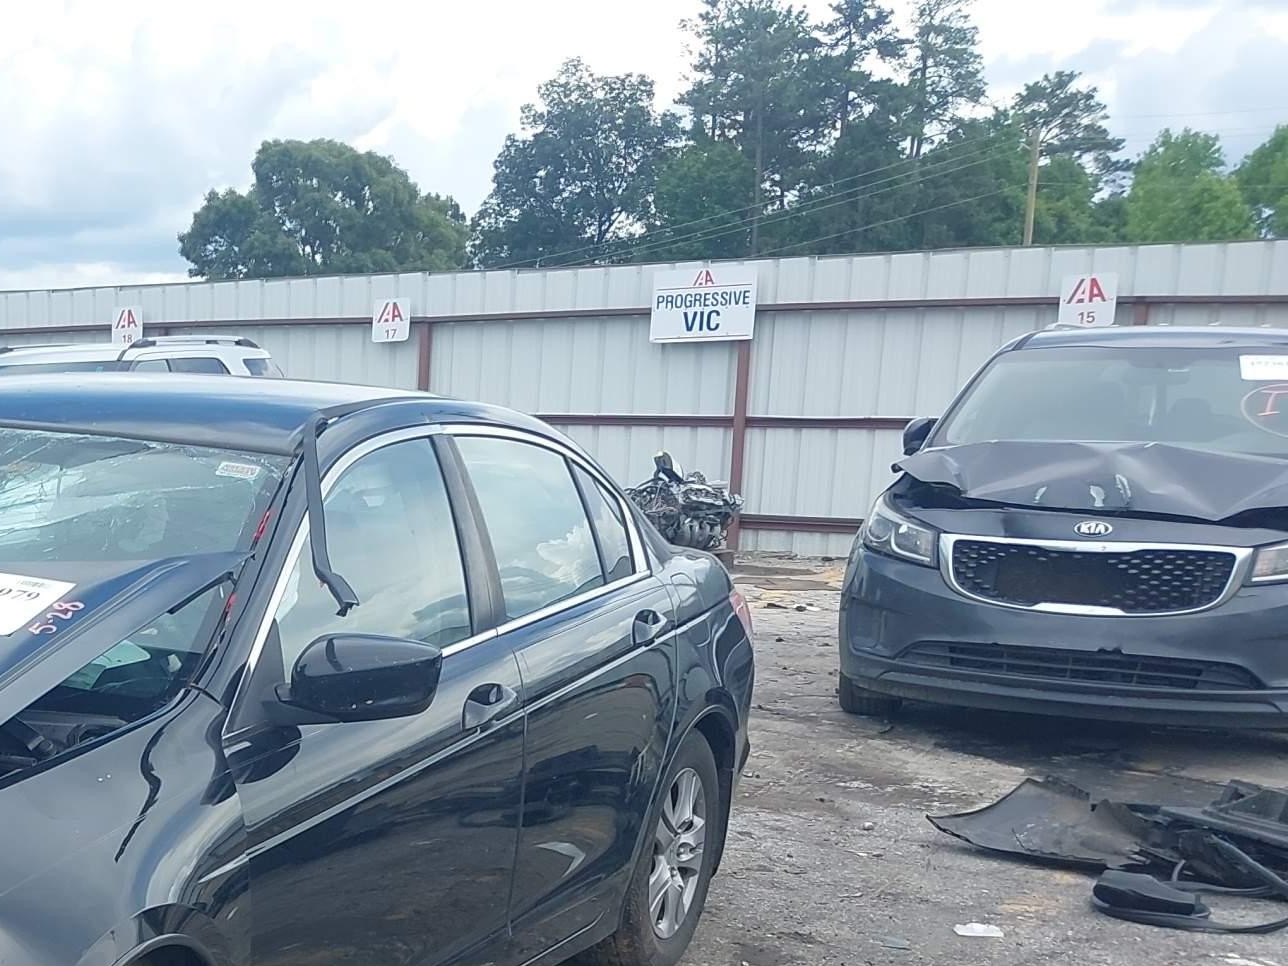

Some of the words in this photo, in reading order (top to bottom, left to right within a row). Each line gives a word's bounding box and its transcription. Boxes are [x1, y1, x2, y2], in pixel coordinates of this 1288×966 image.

[657, 290, 751, 310] PROGRESSIVE
[683, 309, 721, 332] VIC
[1078, 311, 1096, 324] 15
[122, 334, 133, 344] 18
[385, 328, 398, 339] 17
[1078, 521, 1107, 535] KIA
